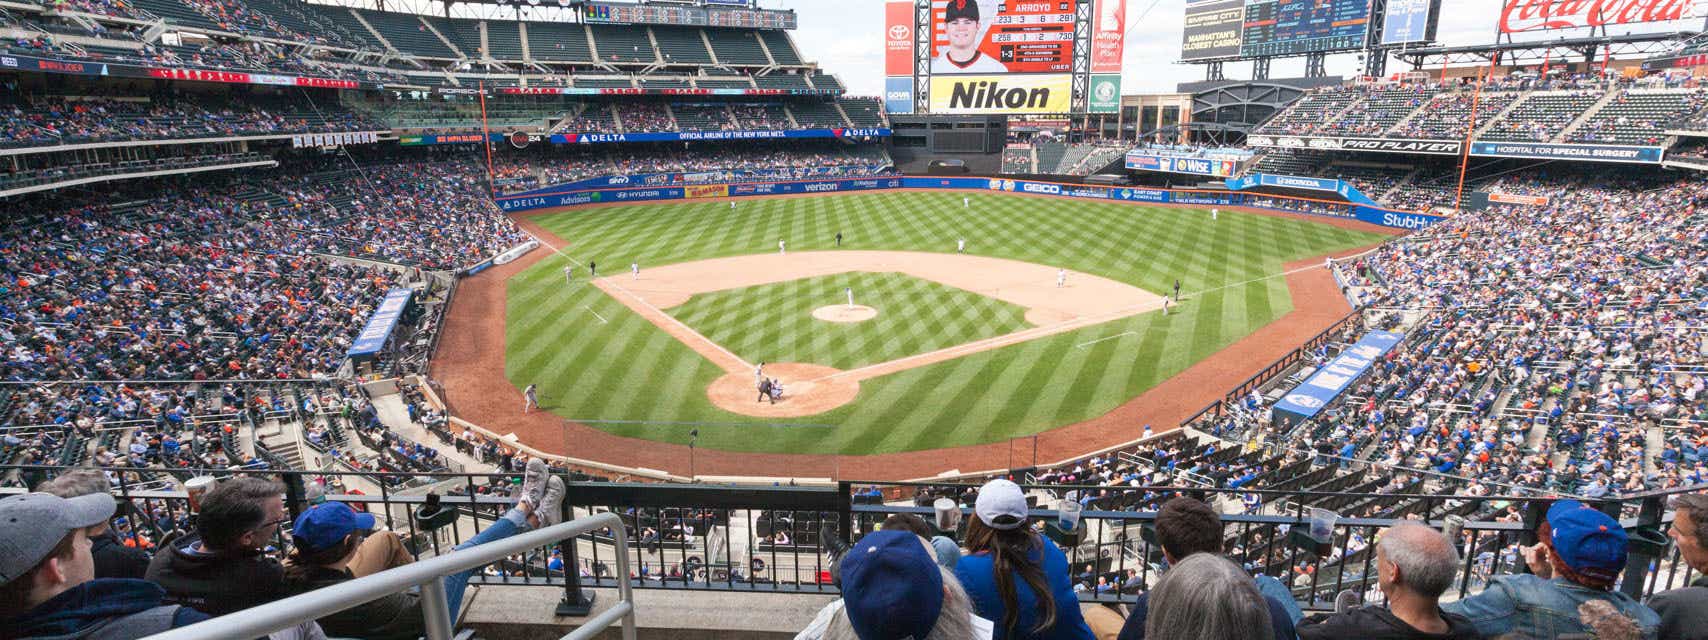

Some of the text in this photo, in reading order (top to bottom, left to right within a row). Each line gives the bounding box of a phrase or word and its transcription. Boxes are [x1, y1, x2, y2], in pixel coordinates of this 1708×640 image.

[1016, 4, 1051, 12] ARROYO
[999, 16, 1011, 24] 233
[1188, 15, 1218, 24] EMPIRE
[1096, 32, 1121, 41] Affinity
[1188, 31, 1236, 43] MANHATTAN'S
[1183, 41, 1212, 51] CLOSEST
[1213, 38, 1240, 48] CASINO
[949, 81, 1050, 109] Nikon
[591, 134, 626, 142] DELTA
[679, 132, 703, 140] OFFICIAL
[704, 131, 724, 139] AIRLINE
[725, 131, 732, 139] OF
[1342, 140, 1378, 149] PRO
[1379, 141, 1459, 153] PLAYER
[1496, 146, 1534, 154] HOSPITAL
[1552, 148, 1591, 156] SPECIAL
[1592, 149, 1640, 158] SURGERY
[1187, 160, 1209, 173] WISE
[805, 182, 838, 192] verizon
[1284, 178, 1320, 188] HONDA
[1023, 183, 1060, 194] GEICO
[629, 190, 660, 198] HYUNDAI
[514, 198, 546, 208] DELTA
[561, 195, 591, 206] Advisors
